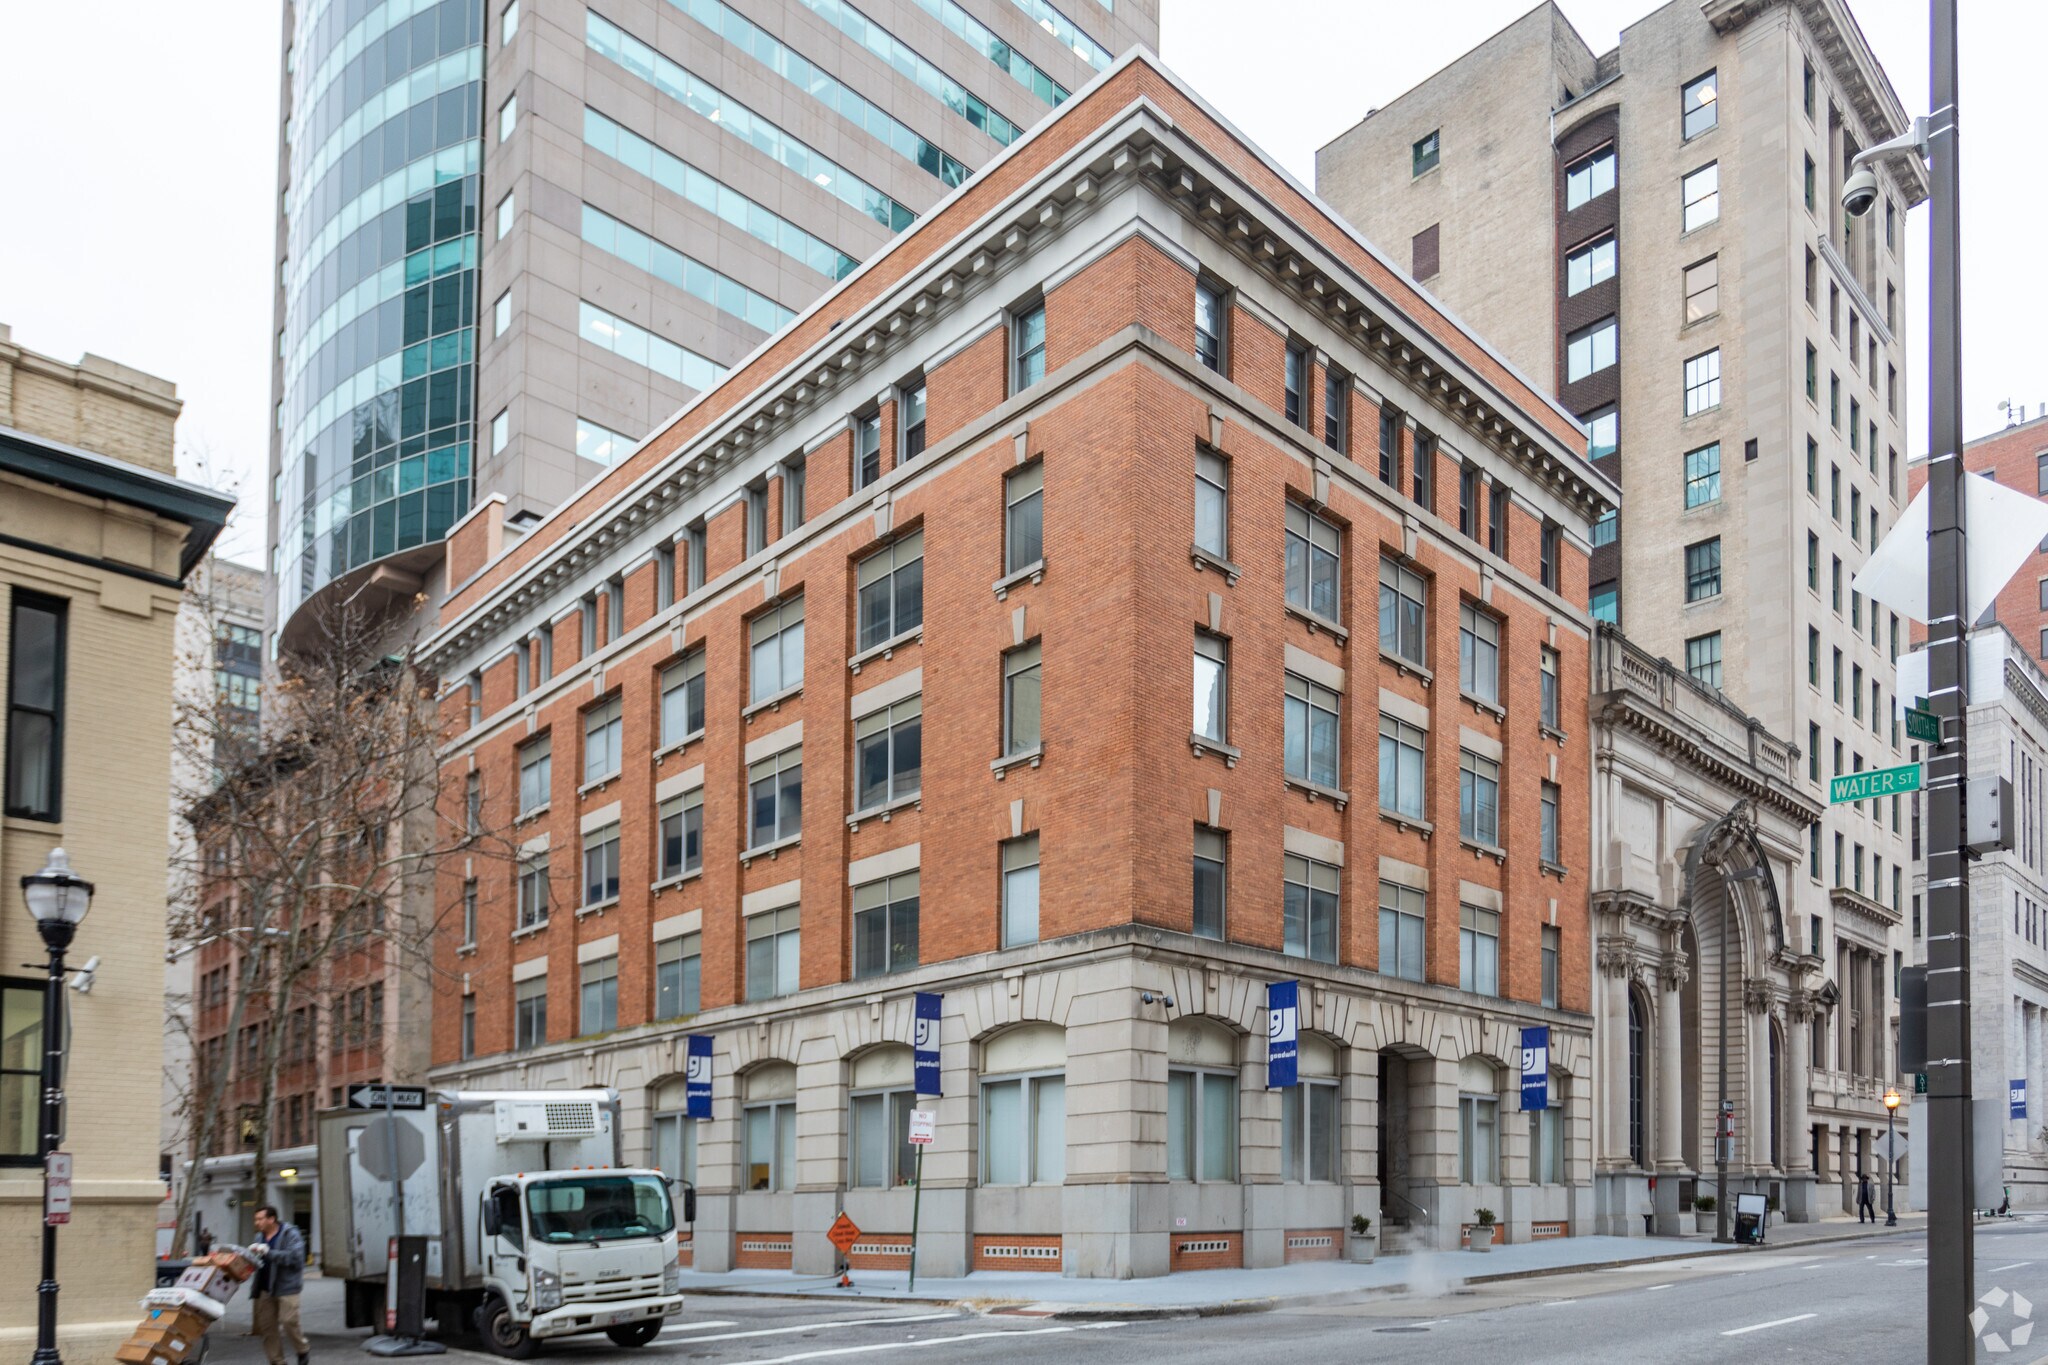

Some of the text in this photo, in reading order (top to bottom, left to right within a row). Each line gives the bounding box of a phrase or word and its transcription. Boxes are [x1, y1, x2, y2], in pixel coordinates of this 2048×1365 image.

[1907, 713, 1930, 737] SOUTH
[1834, 772, 1894, 799] WATER
[1269, 1049, 1296, 1062] goodwill
[1521, 1080, 1547, 1091] goodwill
